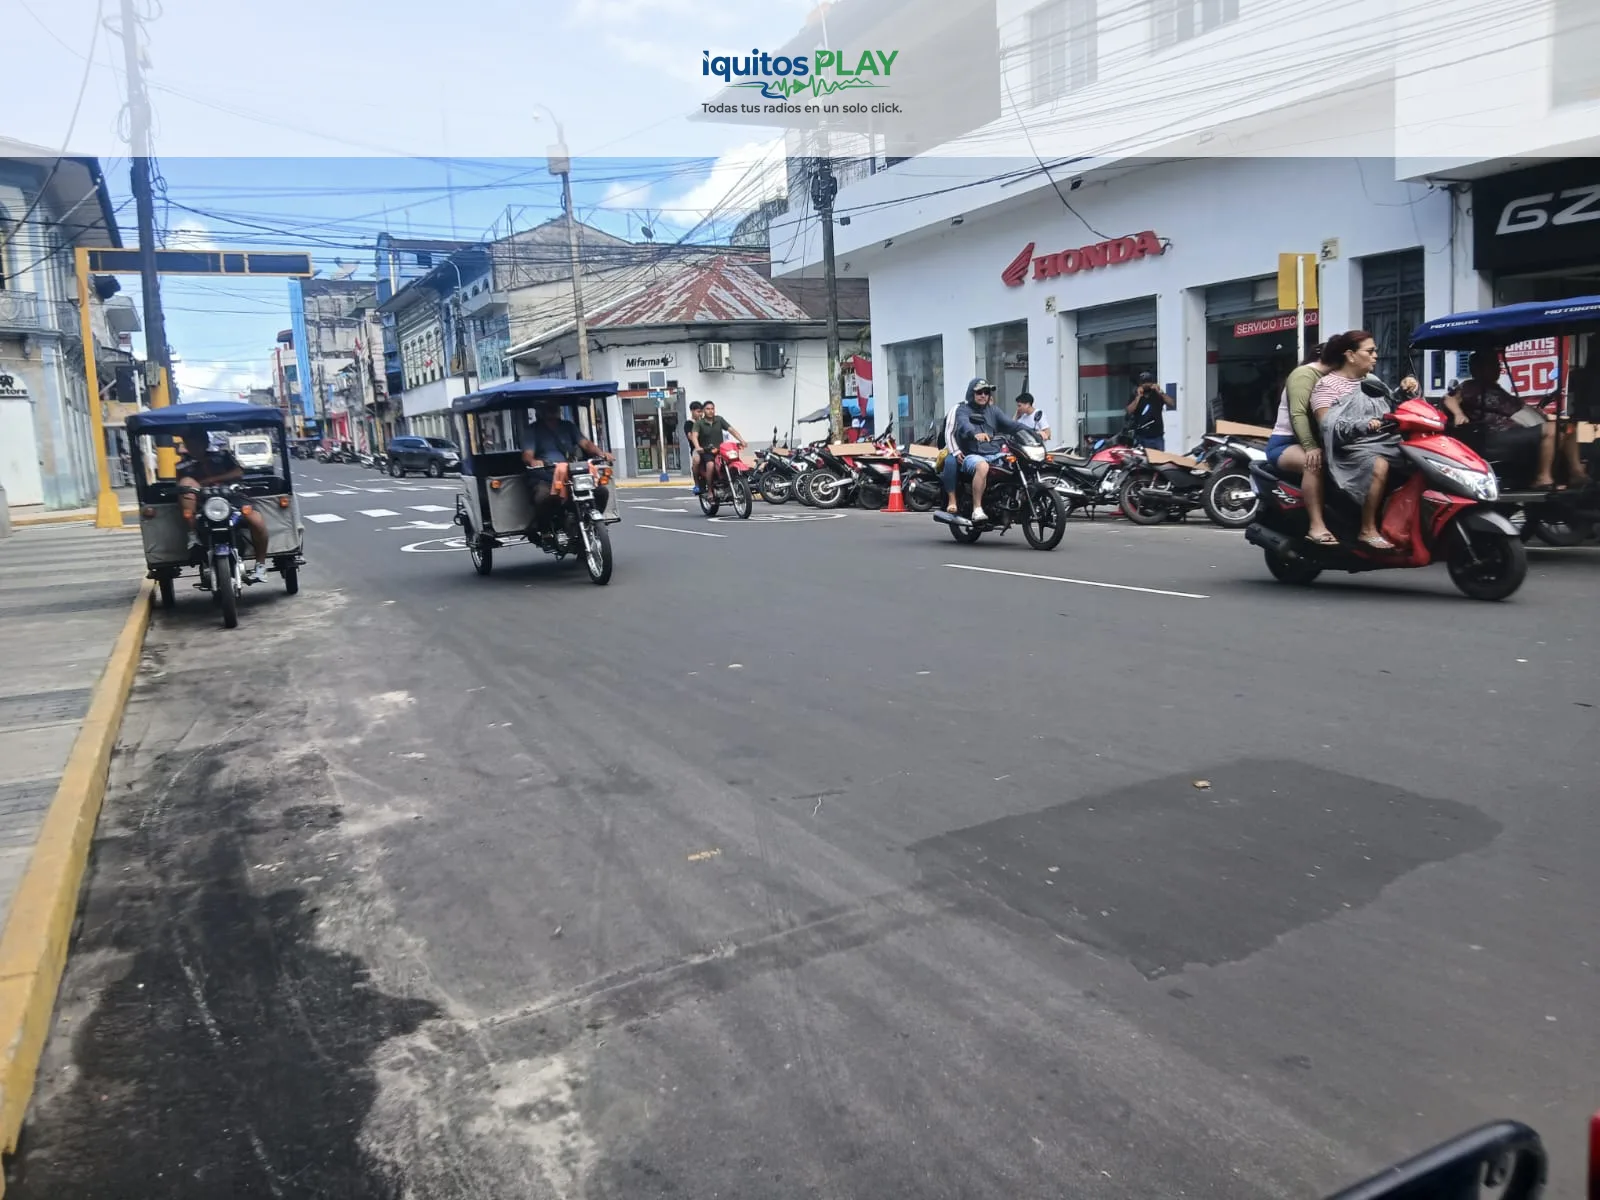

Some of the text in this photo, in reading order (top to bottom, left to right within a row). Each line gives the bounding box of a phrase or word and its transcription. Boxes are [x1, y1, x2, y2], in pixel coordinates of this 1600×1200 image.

[1031, 230, 1162, 280] HONDA
[1236, 311, 1318, 335] SERVICIO TECCO
[626, 357, 661, 368] Mifarma
[1511, 361, 1555, 393] 50
